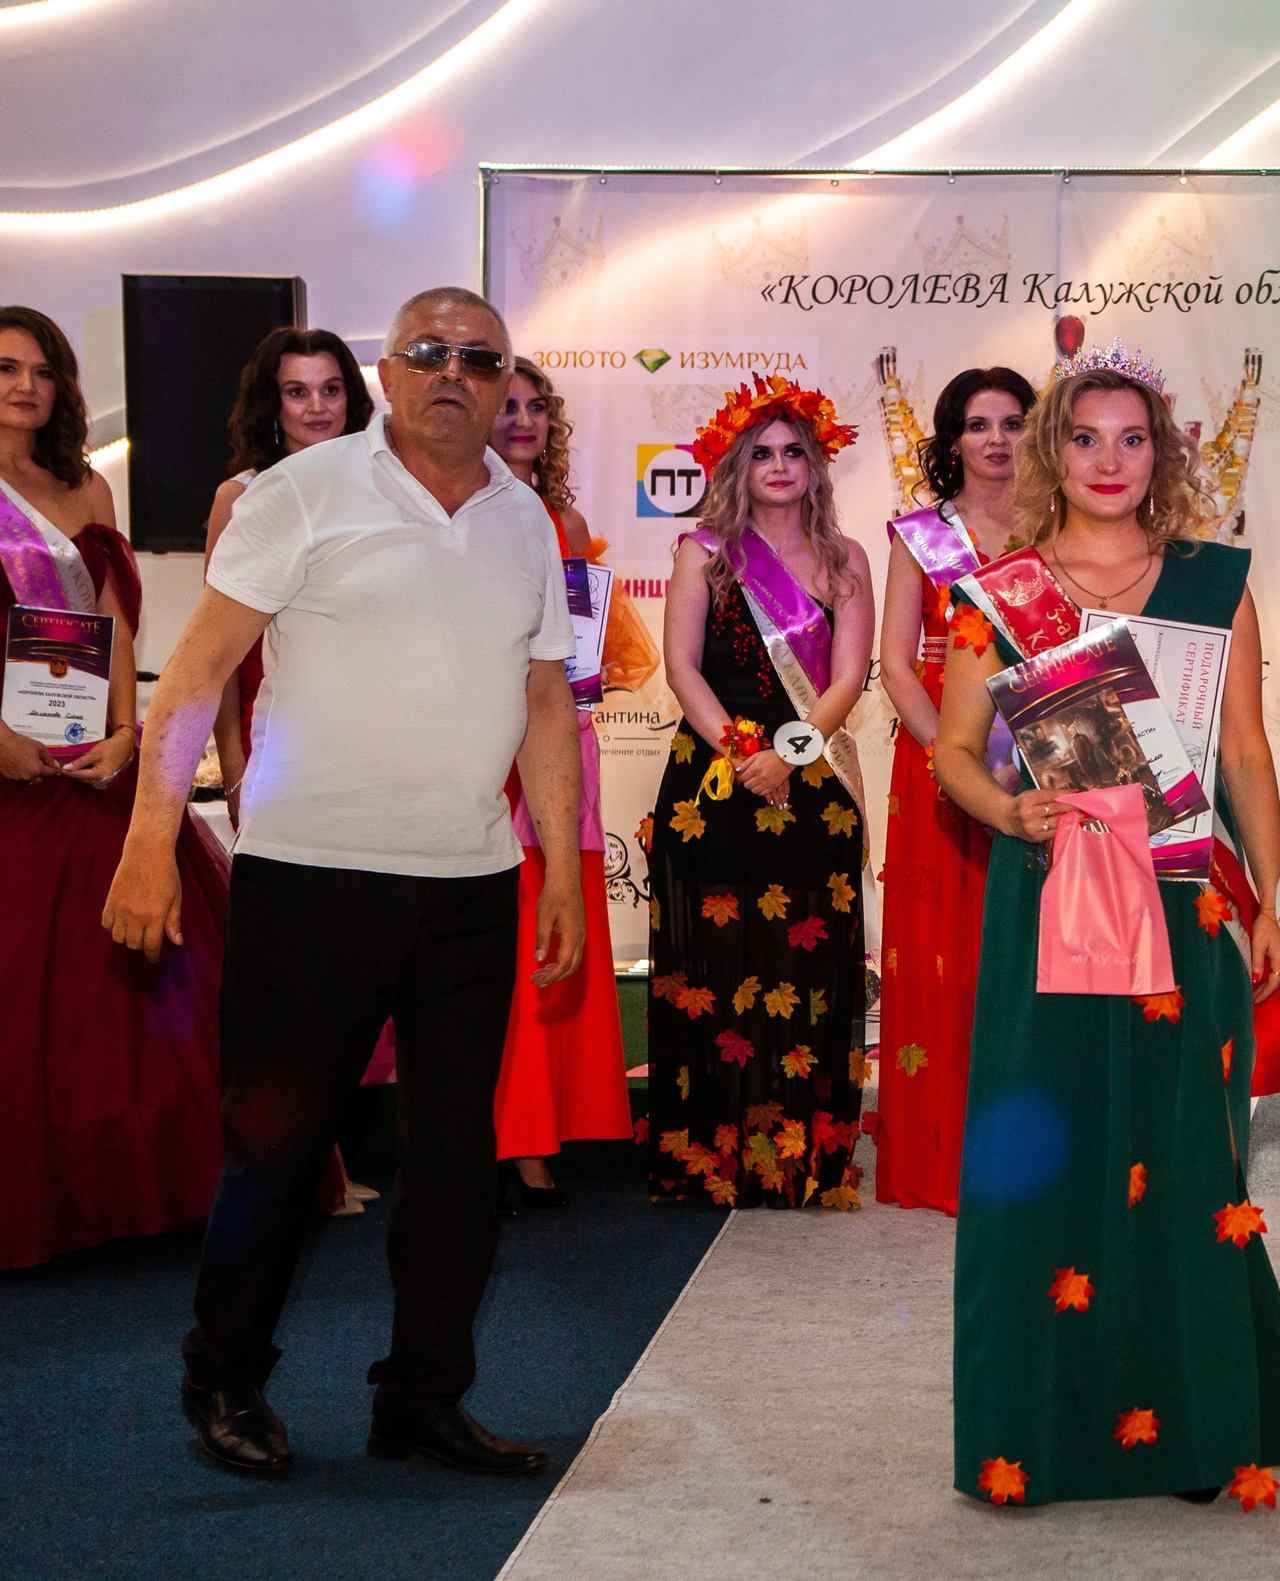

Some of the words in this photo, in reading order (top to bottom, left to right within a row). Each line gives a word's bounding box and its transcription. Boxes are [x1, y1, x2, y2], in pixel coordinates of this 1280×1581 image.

[760, 272, 1009, 311] «КОРОЛЕВА
[1022, 272, 1223, 316] Калужской
[532, 350, 627, 369] ЗОЛОТО
[680, 351, 808, 373] ИЗУМРУДА
[650, 468, 702, 496] ПТ
[21, 613, 101, 635] CERTIFICATE
[1008, 636, 1117, 694] CERTIFICATE
[1175, 641, 1198, 726] СЕРТИФИКАТ
[1192, 642, 1215, 731] ПОДАРОЧНЫЙ
[48, 699, 66, 708] 2023
[636, 748, 661, 757] отдых
[786, 734, 814, 756] 4
